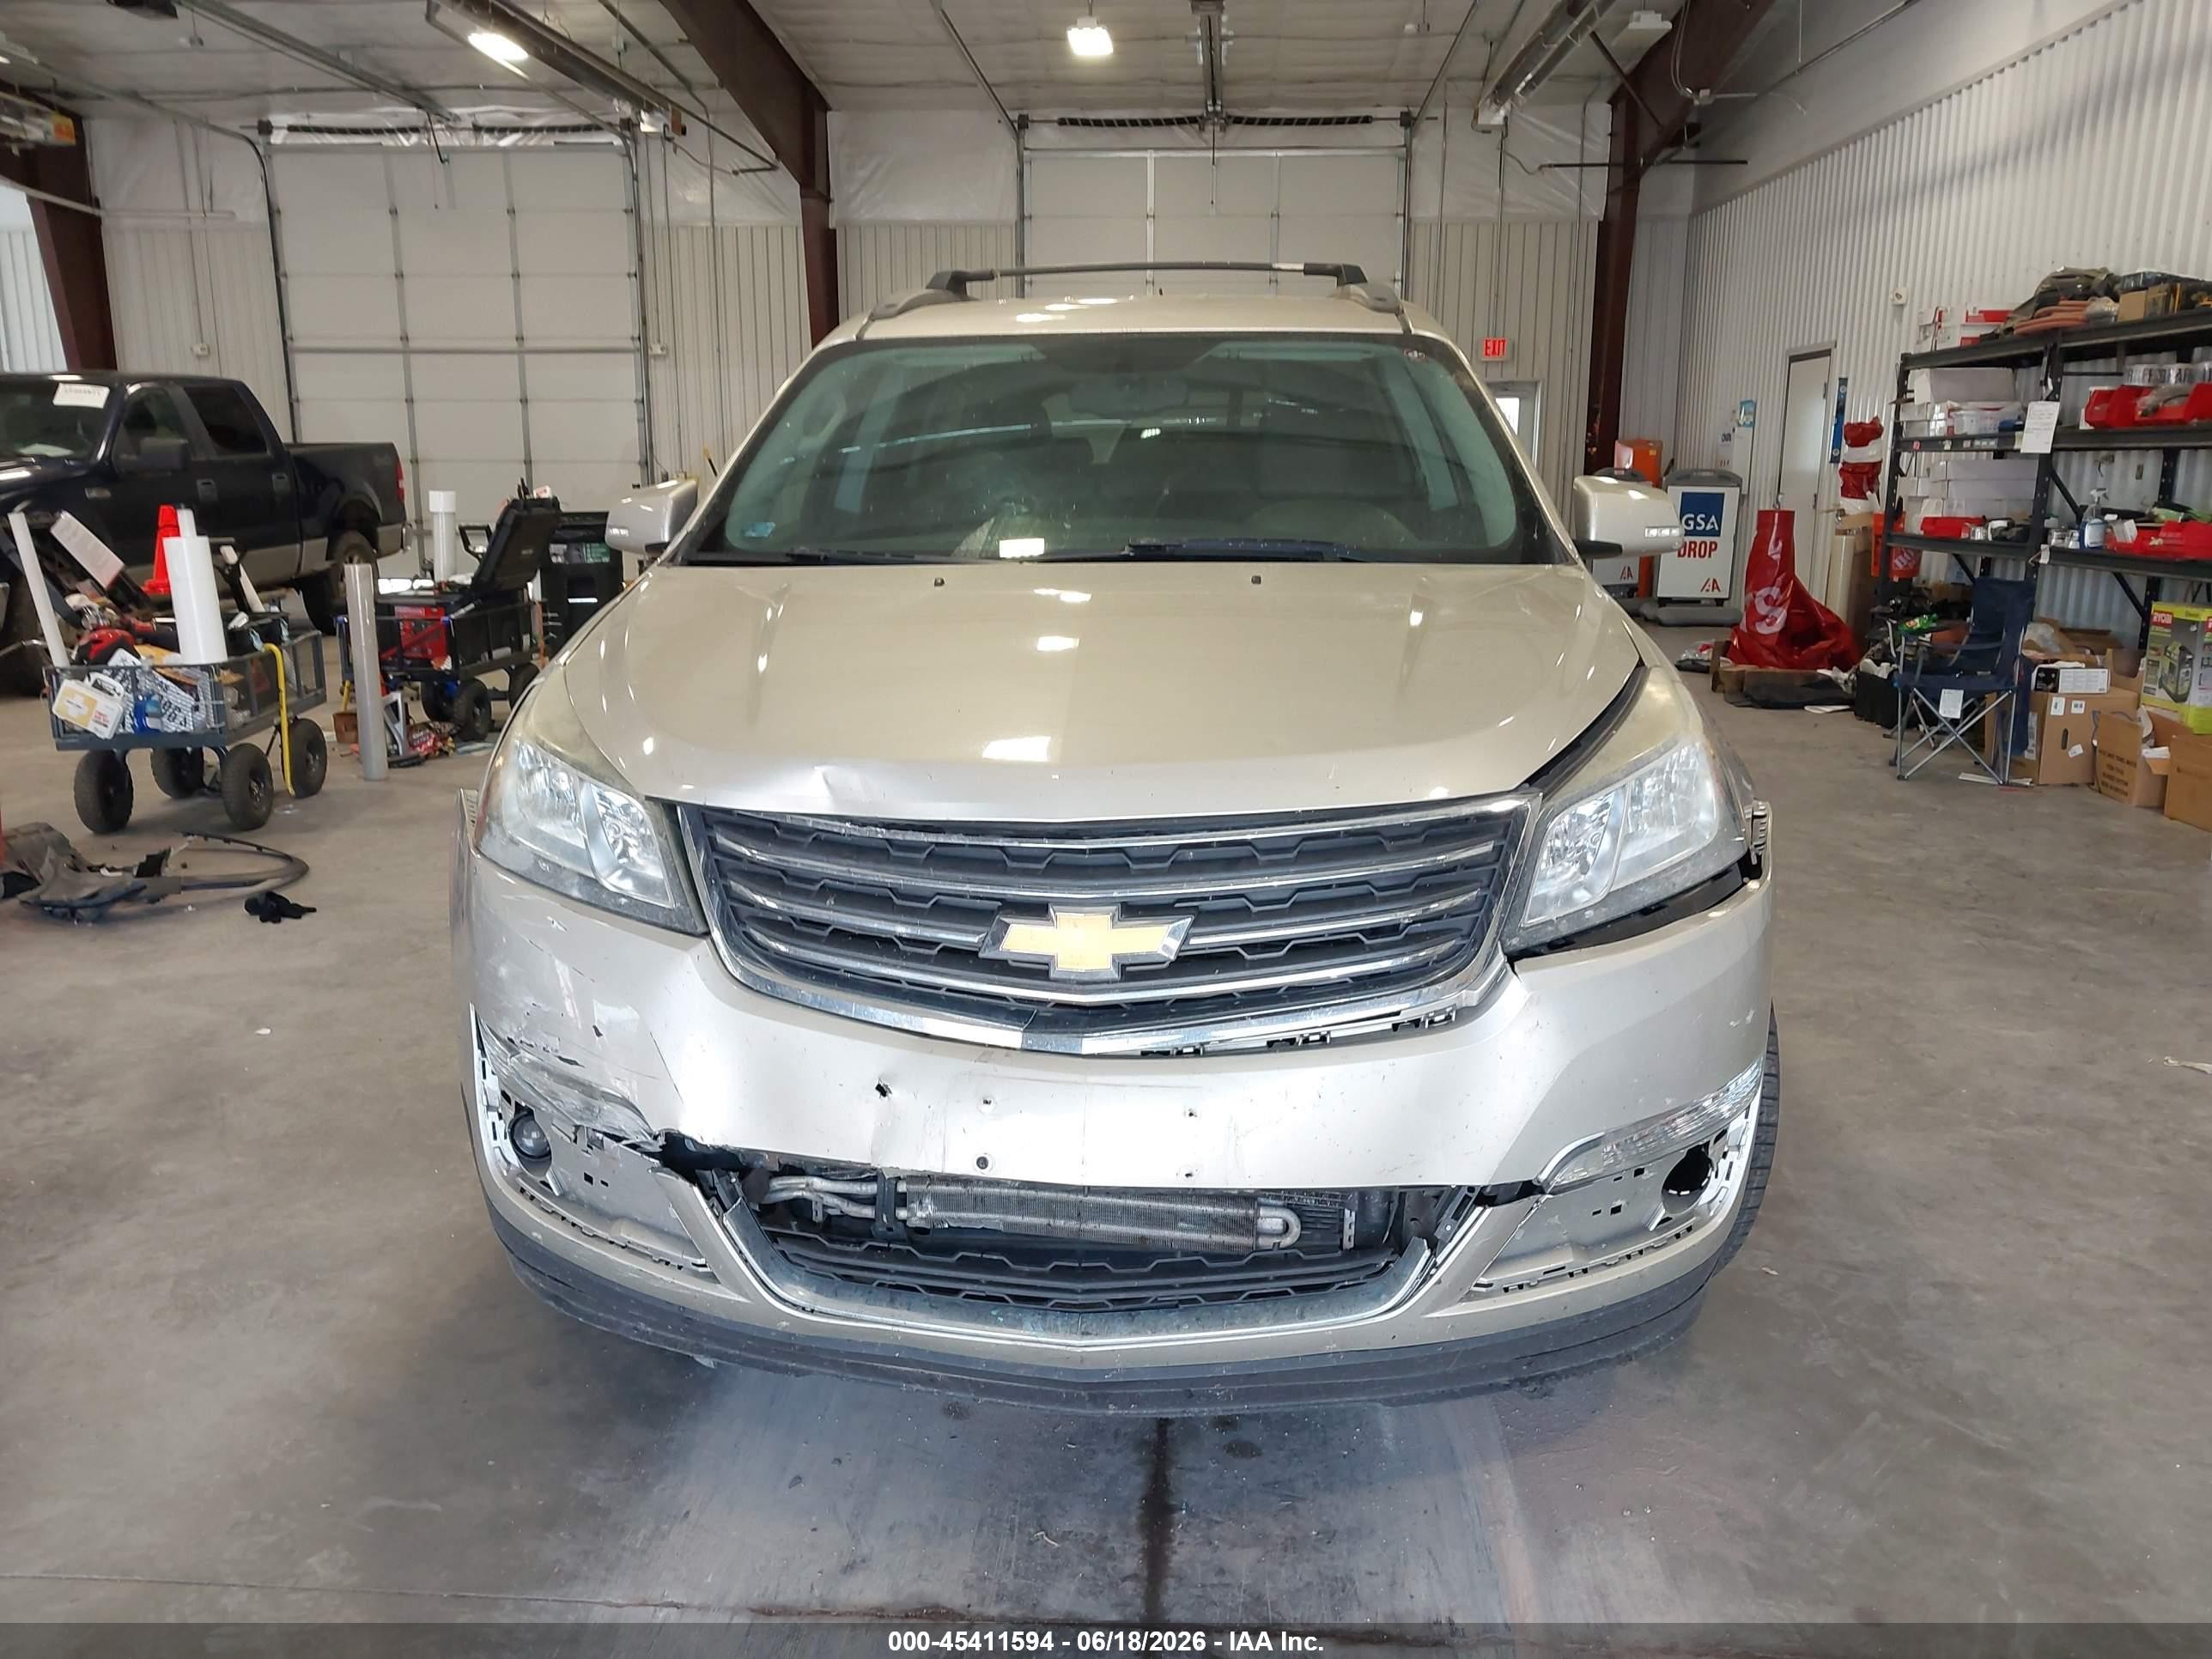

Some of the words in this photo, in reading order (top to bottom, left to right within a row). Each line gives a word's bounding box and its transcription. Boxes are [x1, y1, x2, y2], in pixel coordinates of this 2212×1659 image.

[1485, 338, 1506, 357] EXIT
[1681, 514, 1719, 531] GSA
[1676, 540, 1718, 558] DROP
